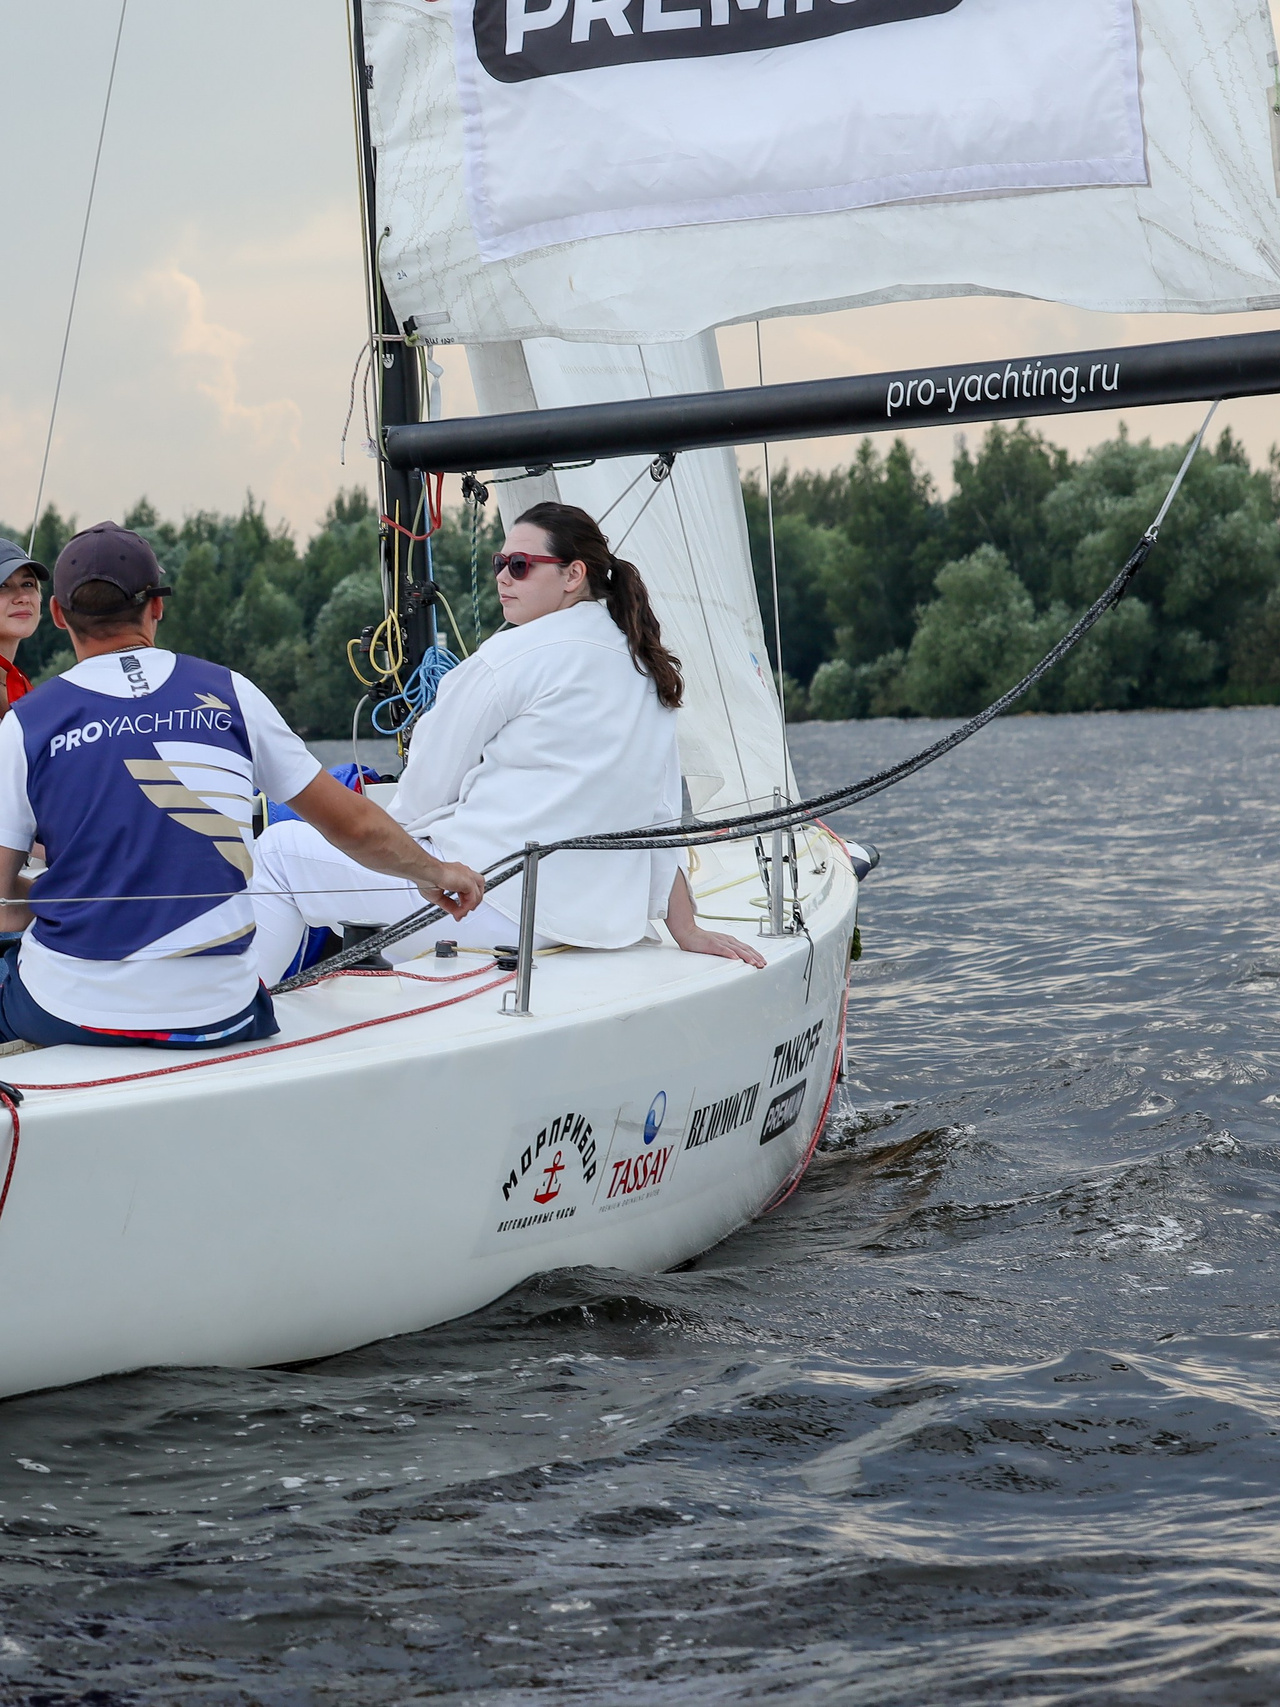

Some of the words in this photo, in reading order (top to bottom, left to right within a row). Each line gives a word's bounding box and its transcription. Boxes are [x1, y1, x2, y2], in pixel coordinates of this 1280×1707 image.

[396, 269, 408, 280] 24
[886, 360, 1120, 417] pro-yachting.ru
[49, 709, 233, 758] PROYACHTING
[770, 1018, 824, 1089] TINKOFF
[684, 1081, 761, 1150] ВЕДОМОСТИ
[501, 1112, 597, 1202] МОРПРИБОР
[606, 1145, 675, 1199] TASSAY
[497, 1211, 554, 1233] ЛЕГЕНДАРНЫЕ
[556, 1206, 577, 1221] ЧАСЫ
